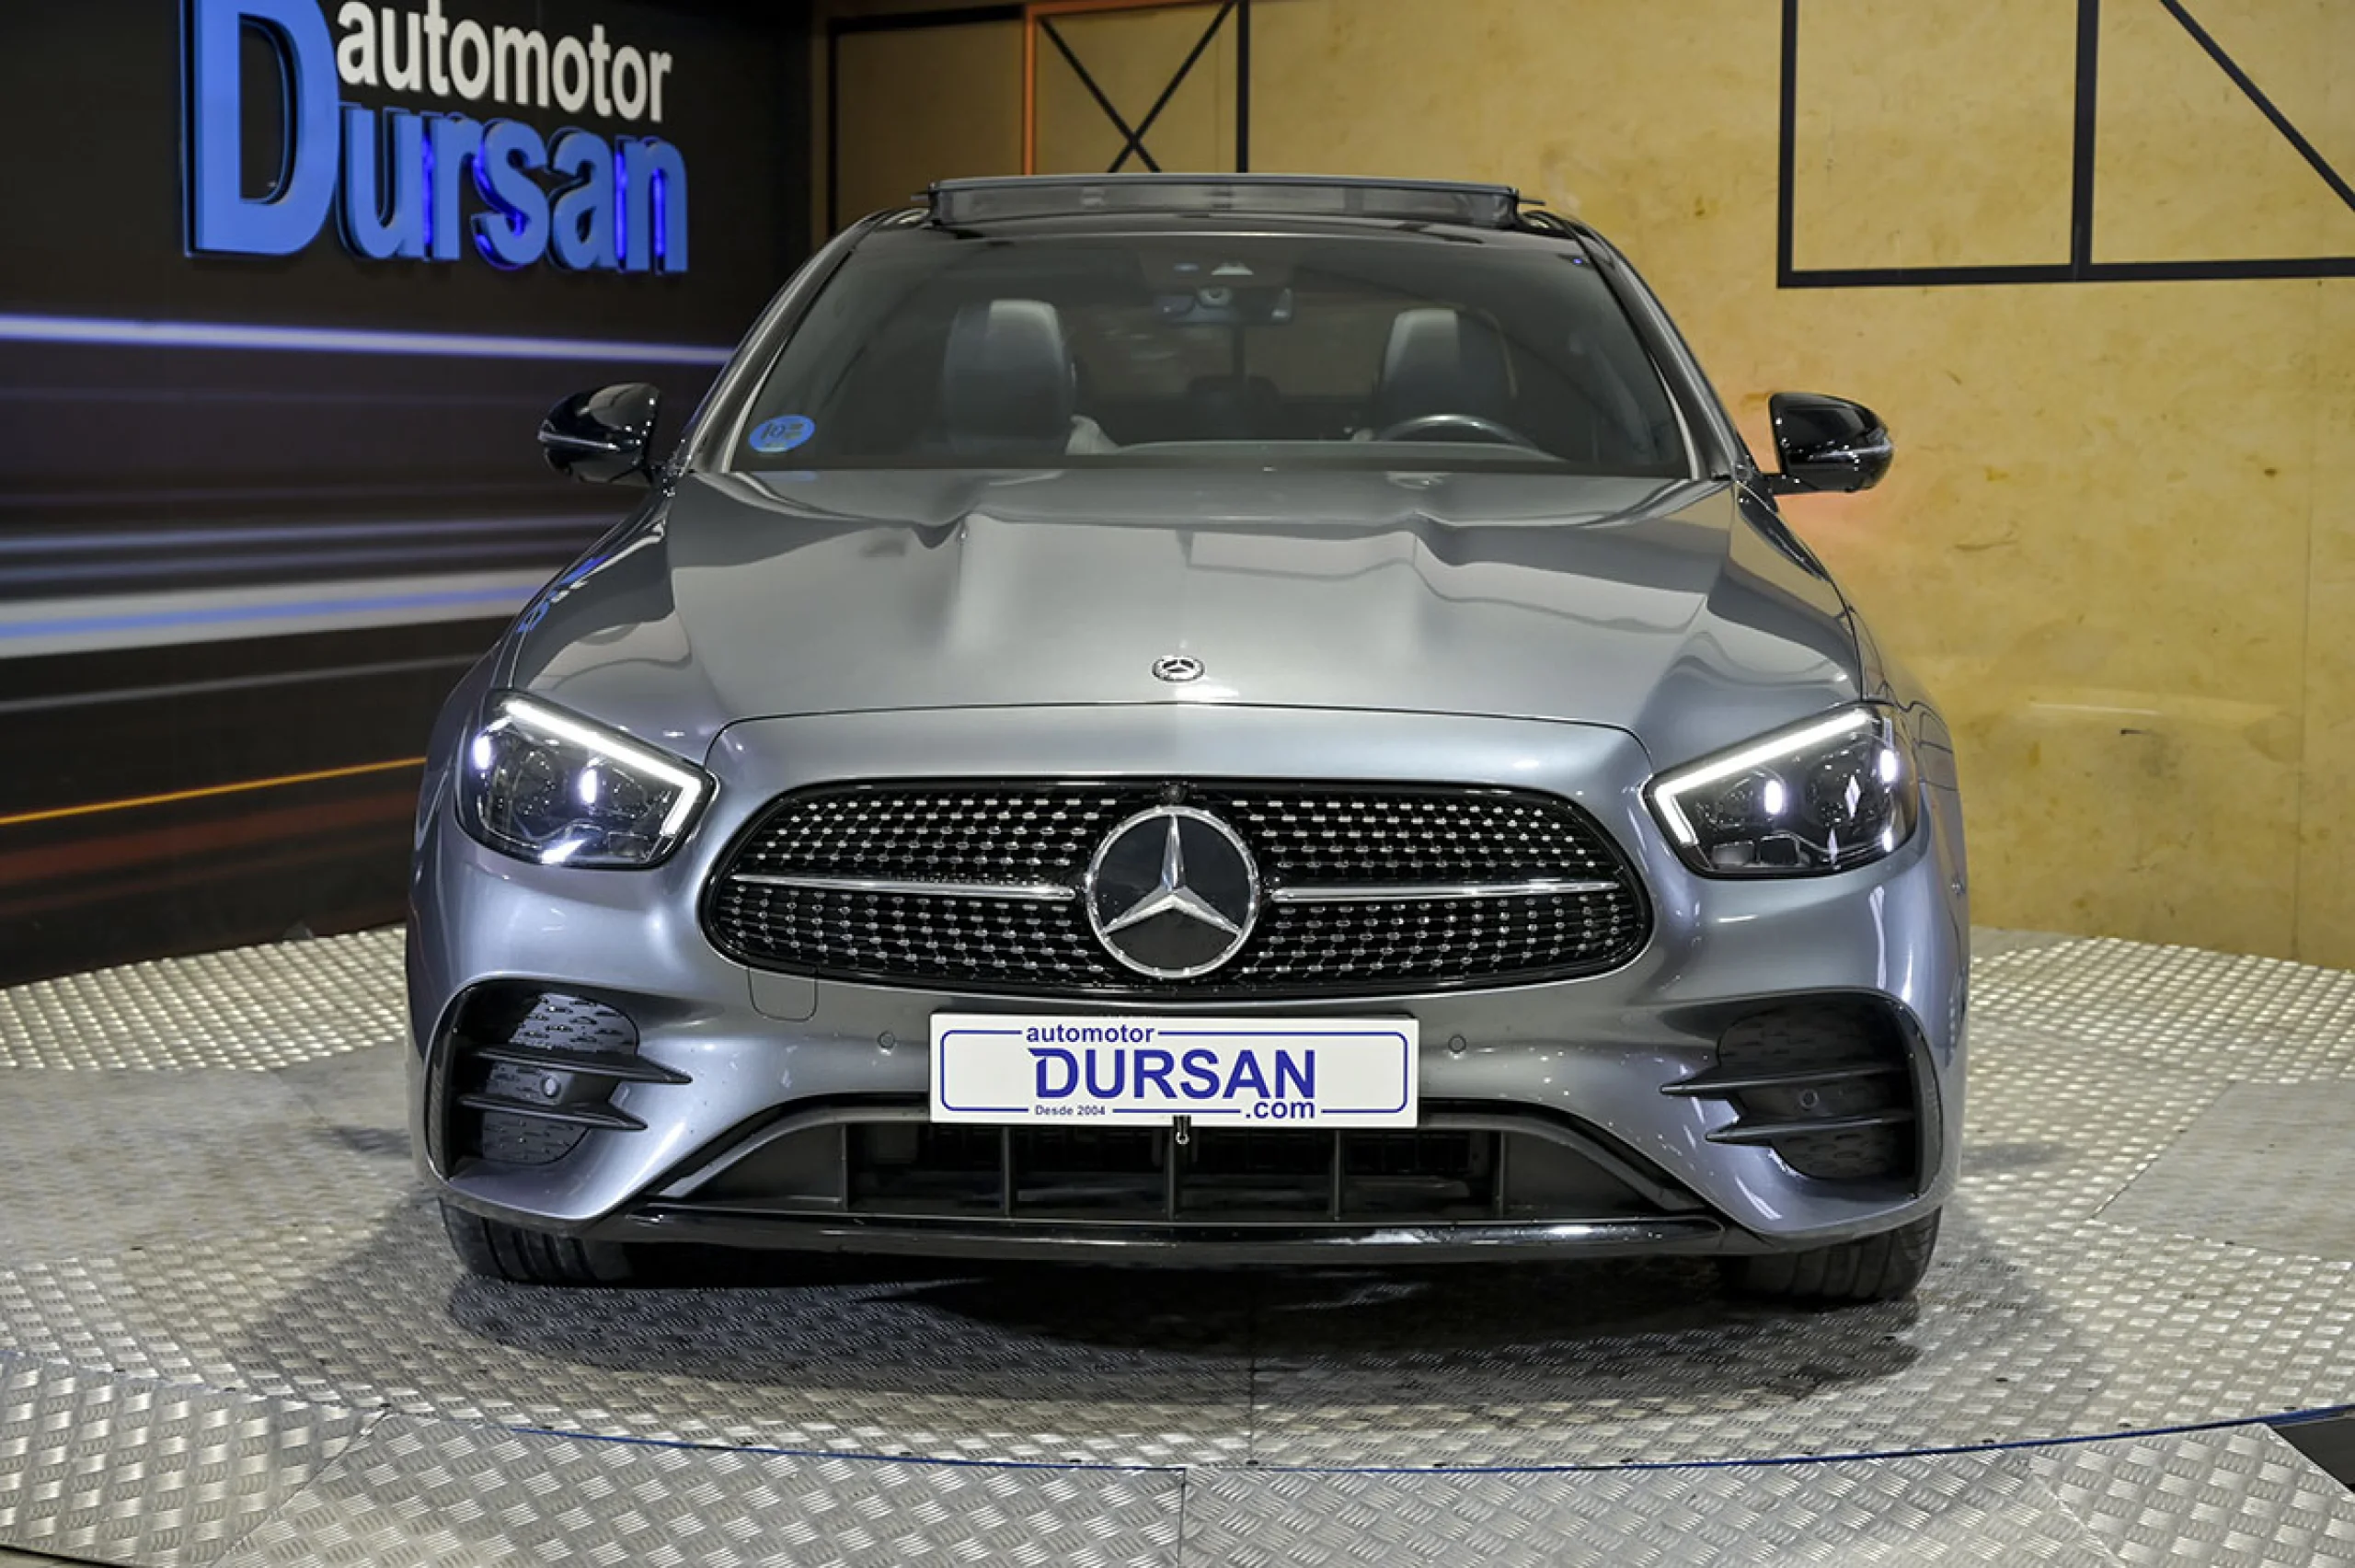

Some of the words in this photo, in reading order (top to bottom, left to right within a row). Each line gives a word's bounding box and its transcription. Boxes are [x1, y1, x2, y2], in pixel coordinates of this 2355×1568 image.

[337, 1, 672, 122] automotor
[182, 0, 688, 273] Dursan
[1026, 1024, 1155, 1043] automotor
[1028, 1048, 1315, 1099] DURSAN
[1035, 1104, 1074, 1116] Desde
[1076, 1104, 1106, 1116] 2004
[1245, 1101, 1315, 1119] .com
